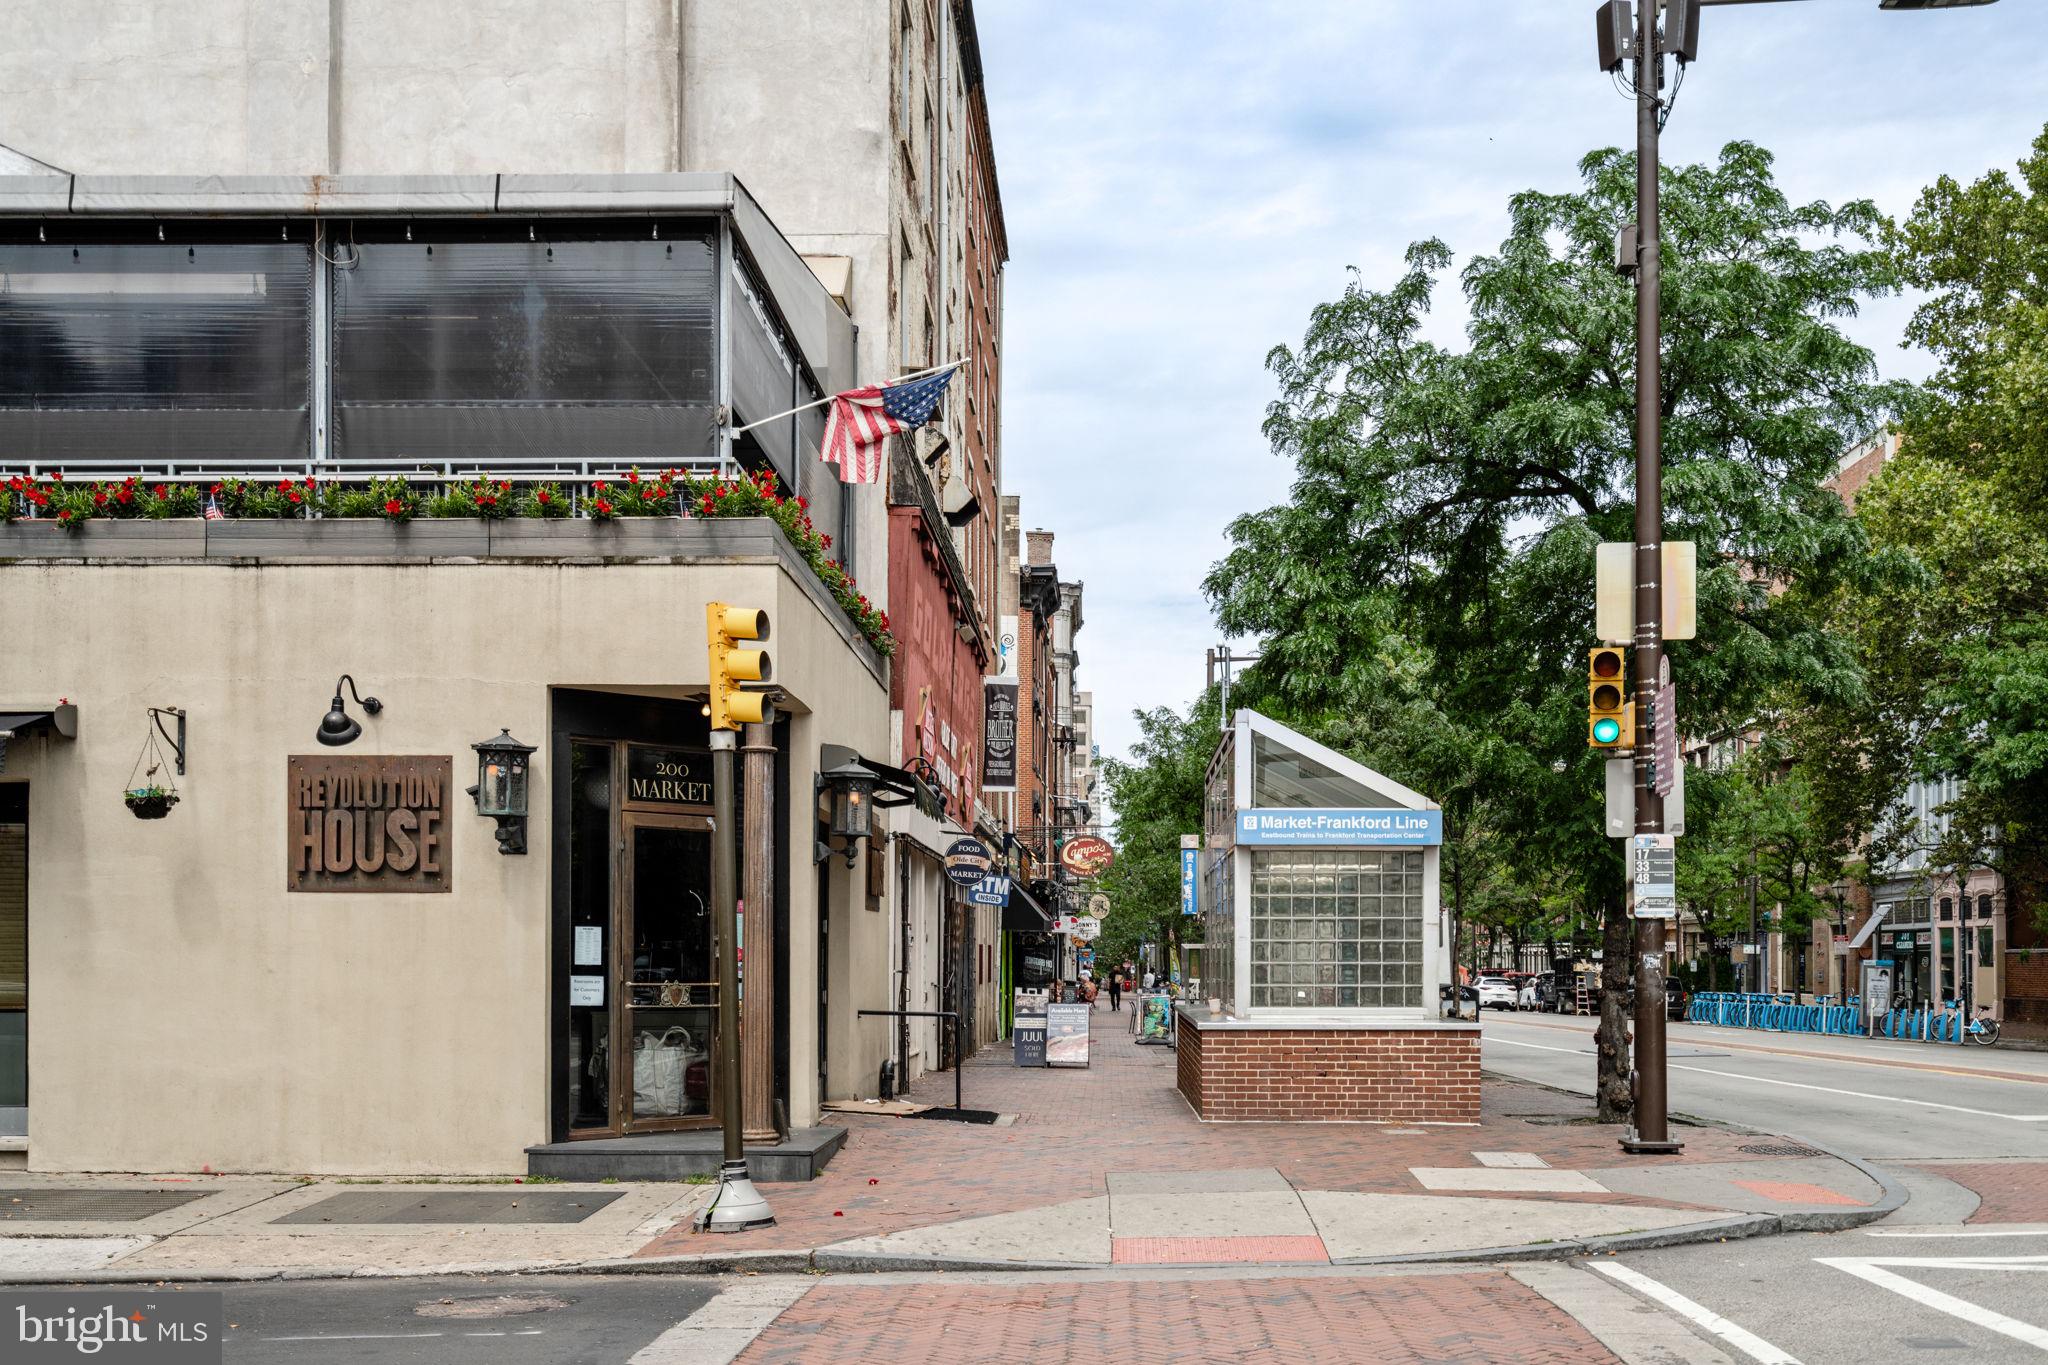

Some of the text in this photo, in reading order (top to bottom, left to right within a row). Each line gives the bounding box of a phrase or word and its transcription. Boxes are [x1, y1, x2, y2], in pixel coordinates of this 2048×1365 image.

[987, 720, 1014, 738] BROTHER
[656, 762, 689, 777] 200
[296, 774, 440, 808] REVOLUTION
[632, 778, 711, 802] MARKET
[1261, 815, 1429, 829] Market-Frankford Line
[295, 808, 440, 873] HOUSE
[1357, 832, 1402, 840] Transportation
[958, 845, 980, 853] FOOD
[1636, 849, 1650, 860] 17
[969, 856, 983, 865] City
[1636, 861, 1650, 873] 33
[950, 870, 984, 879] MARKET
[1636, 873, 1650, 884] 48
[971, 876, 1010, 895] ATM
[978, 894, 1000, 903] INSIDE
